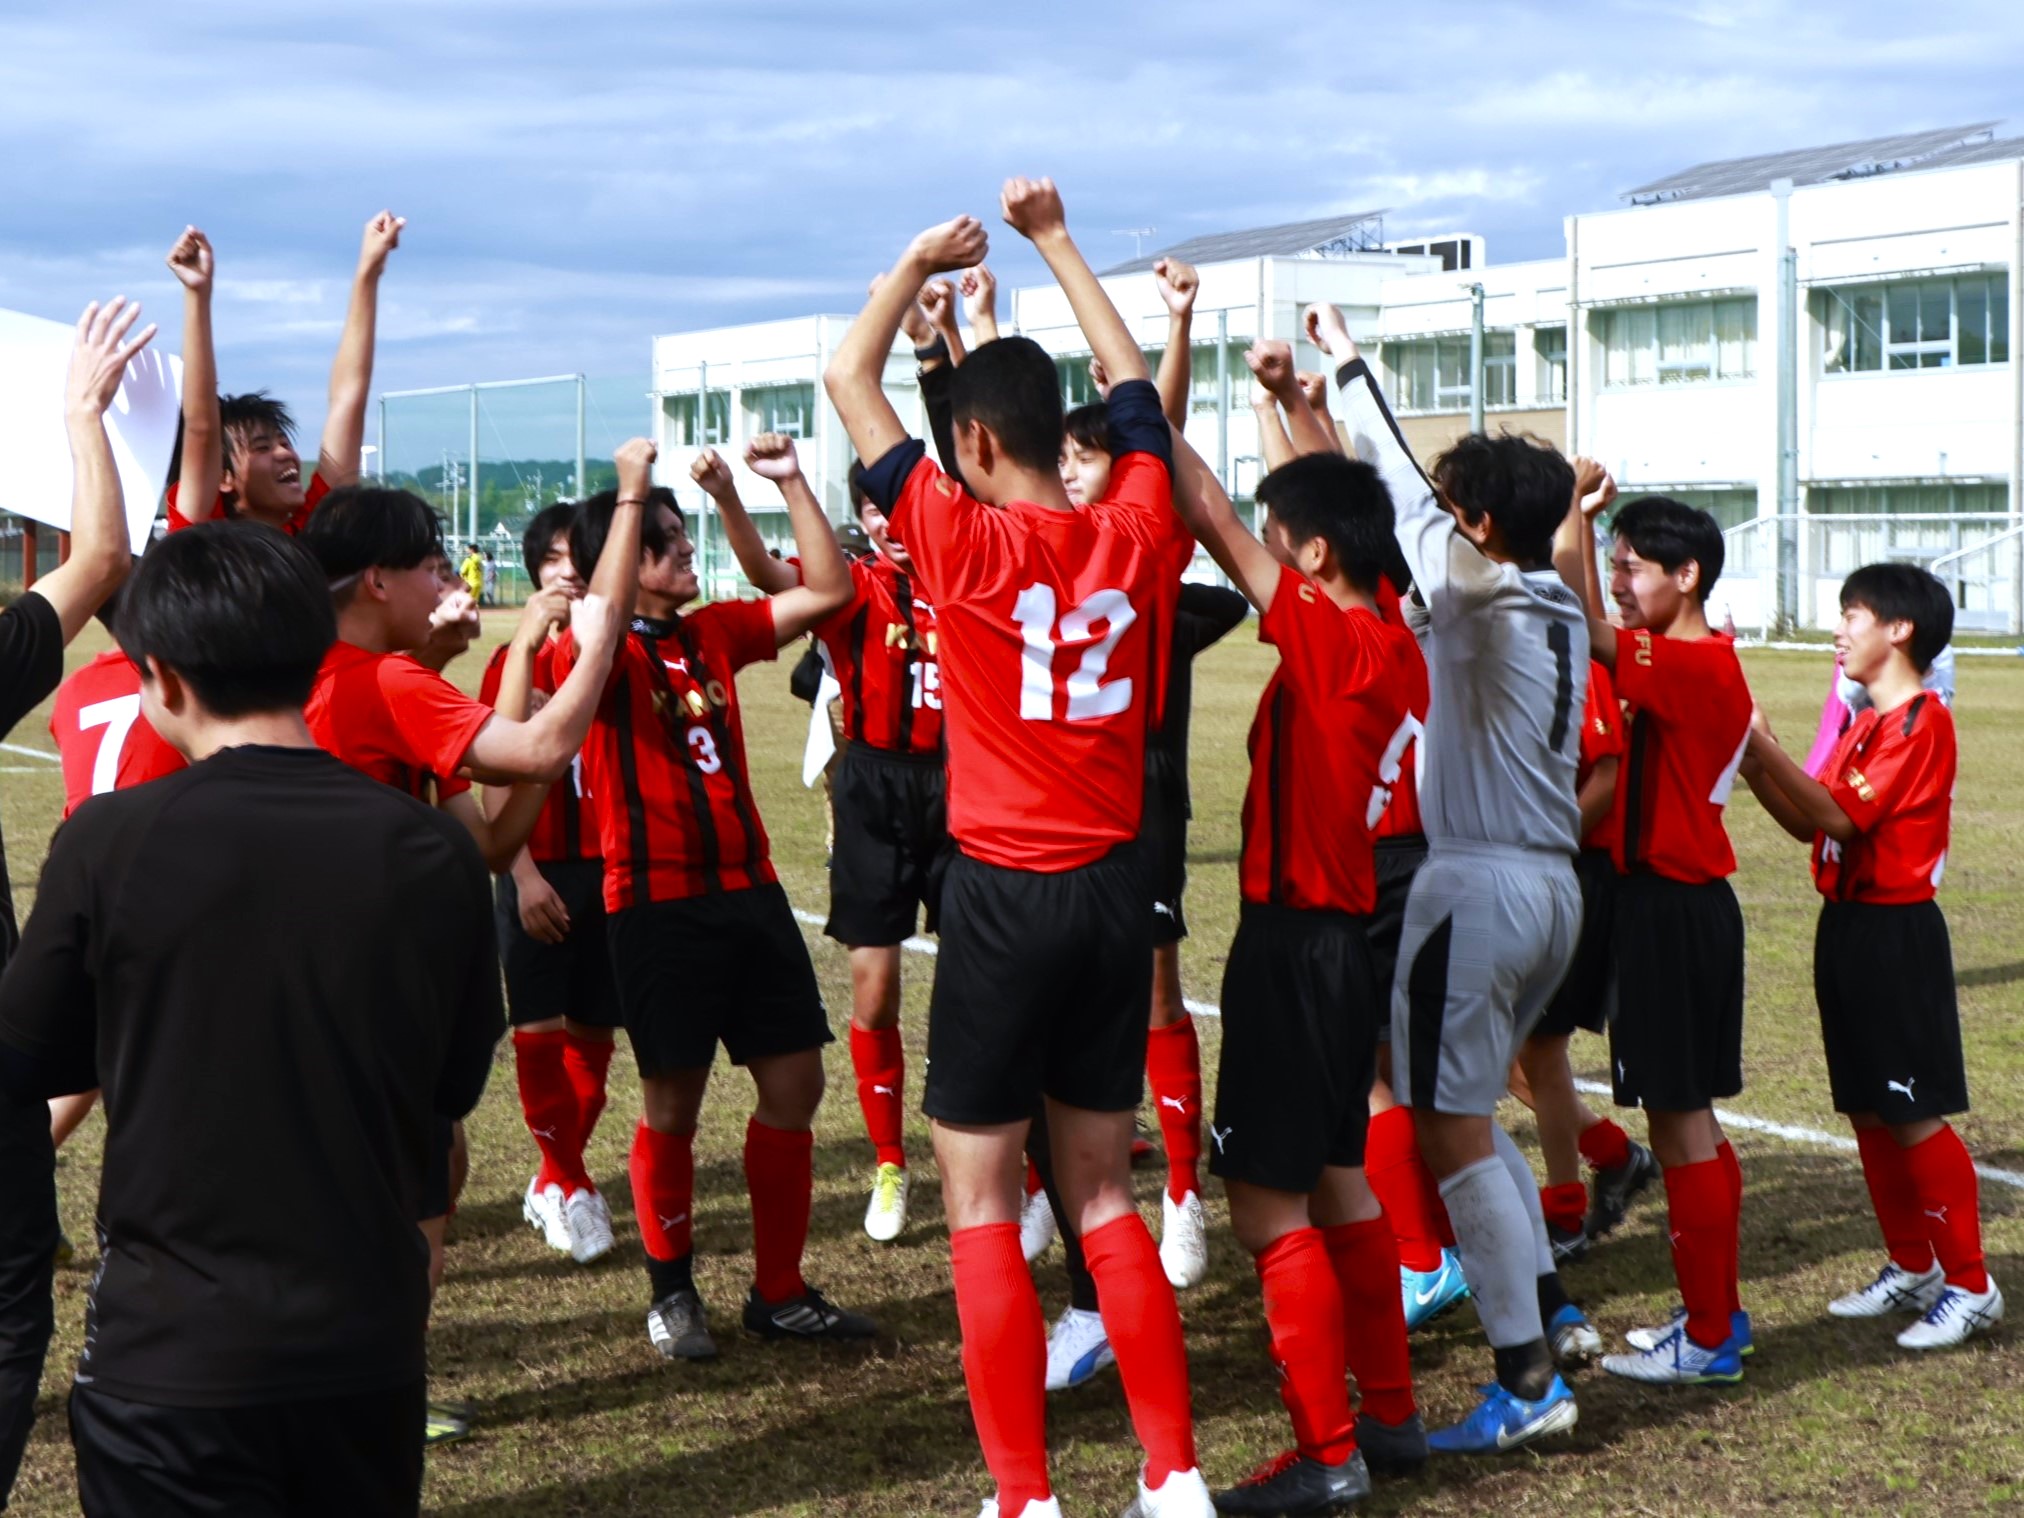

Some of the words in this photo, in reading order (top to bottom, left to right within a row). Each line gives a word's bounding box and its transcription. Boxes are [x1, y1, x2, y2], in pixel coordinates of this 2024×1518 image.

[909, 661, 943, 710] 15
[1010, 581, 1138, 721] 12
[1547, 620, 1574, 753] 1
[79, 693, 141, 796] 7
[687, 725, 721, 775] 3
